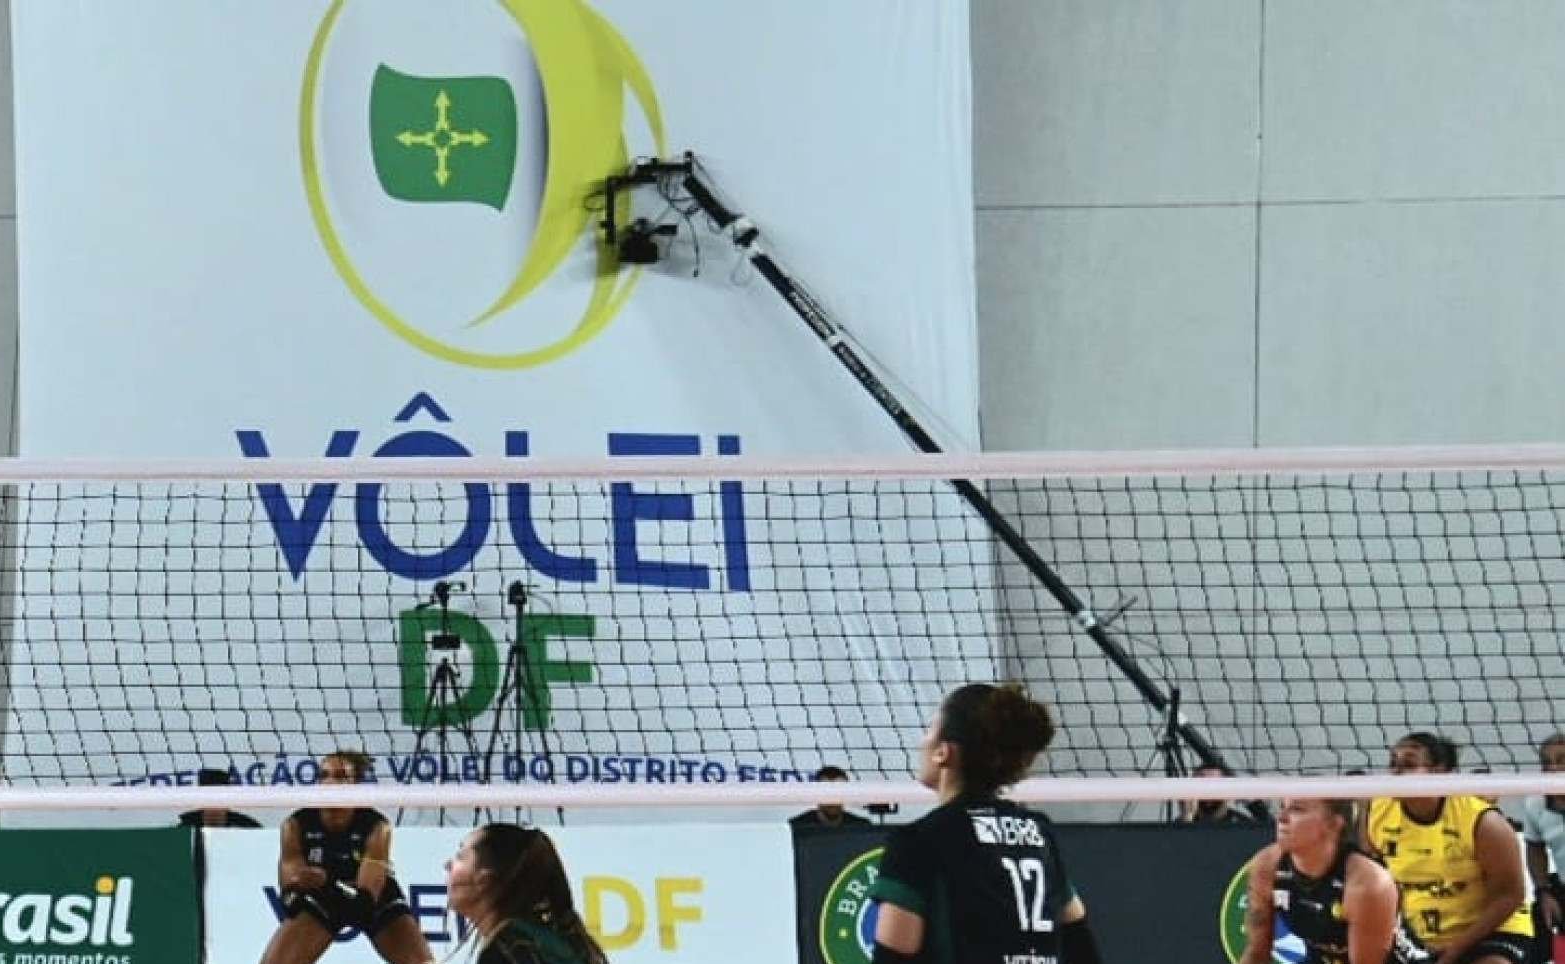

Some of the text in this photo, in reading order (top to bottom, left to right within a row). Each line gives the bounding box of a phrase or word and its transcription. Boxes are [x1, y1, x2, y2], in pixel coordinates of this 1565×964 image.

[235, 392, 750, 592] VÔLEI
[399, 611, 596, 732] DF
[566, 755, 728, 784] DISTRITO
[582, 874, 704, 952] DF
[1002, 857, 1054, 932] 12
